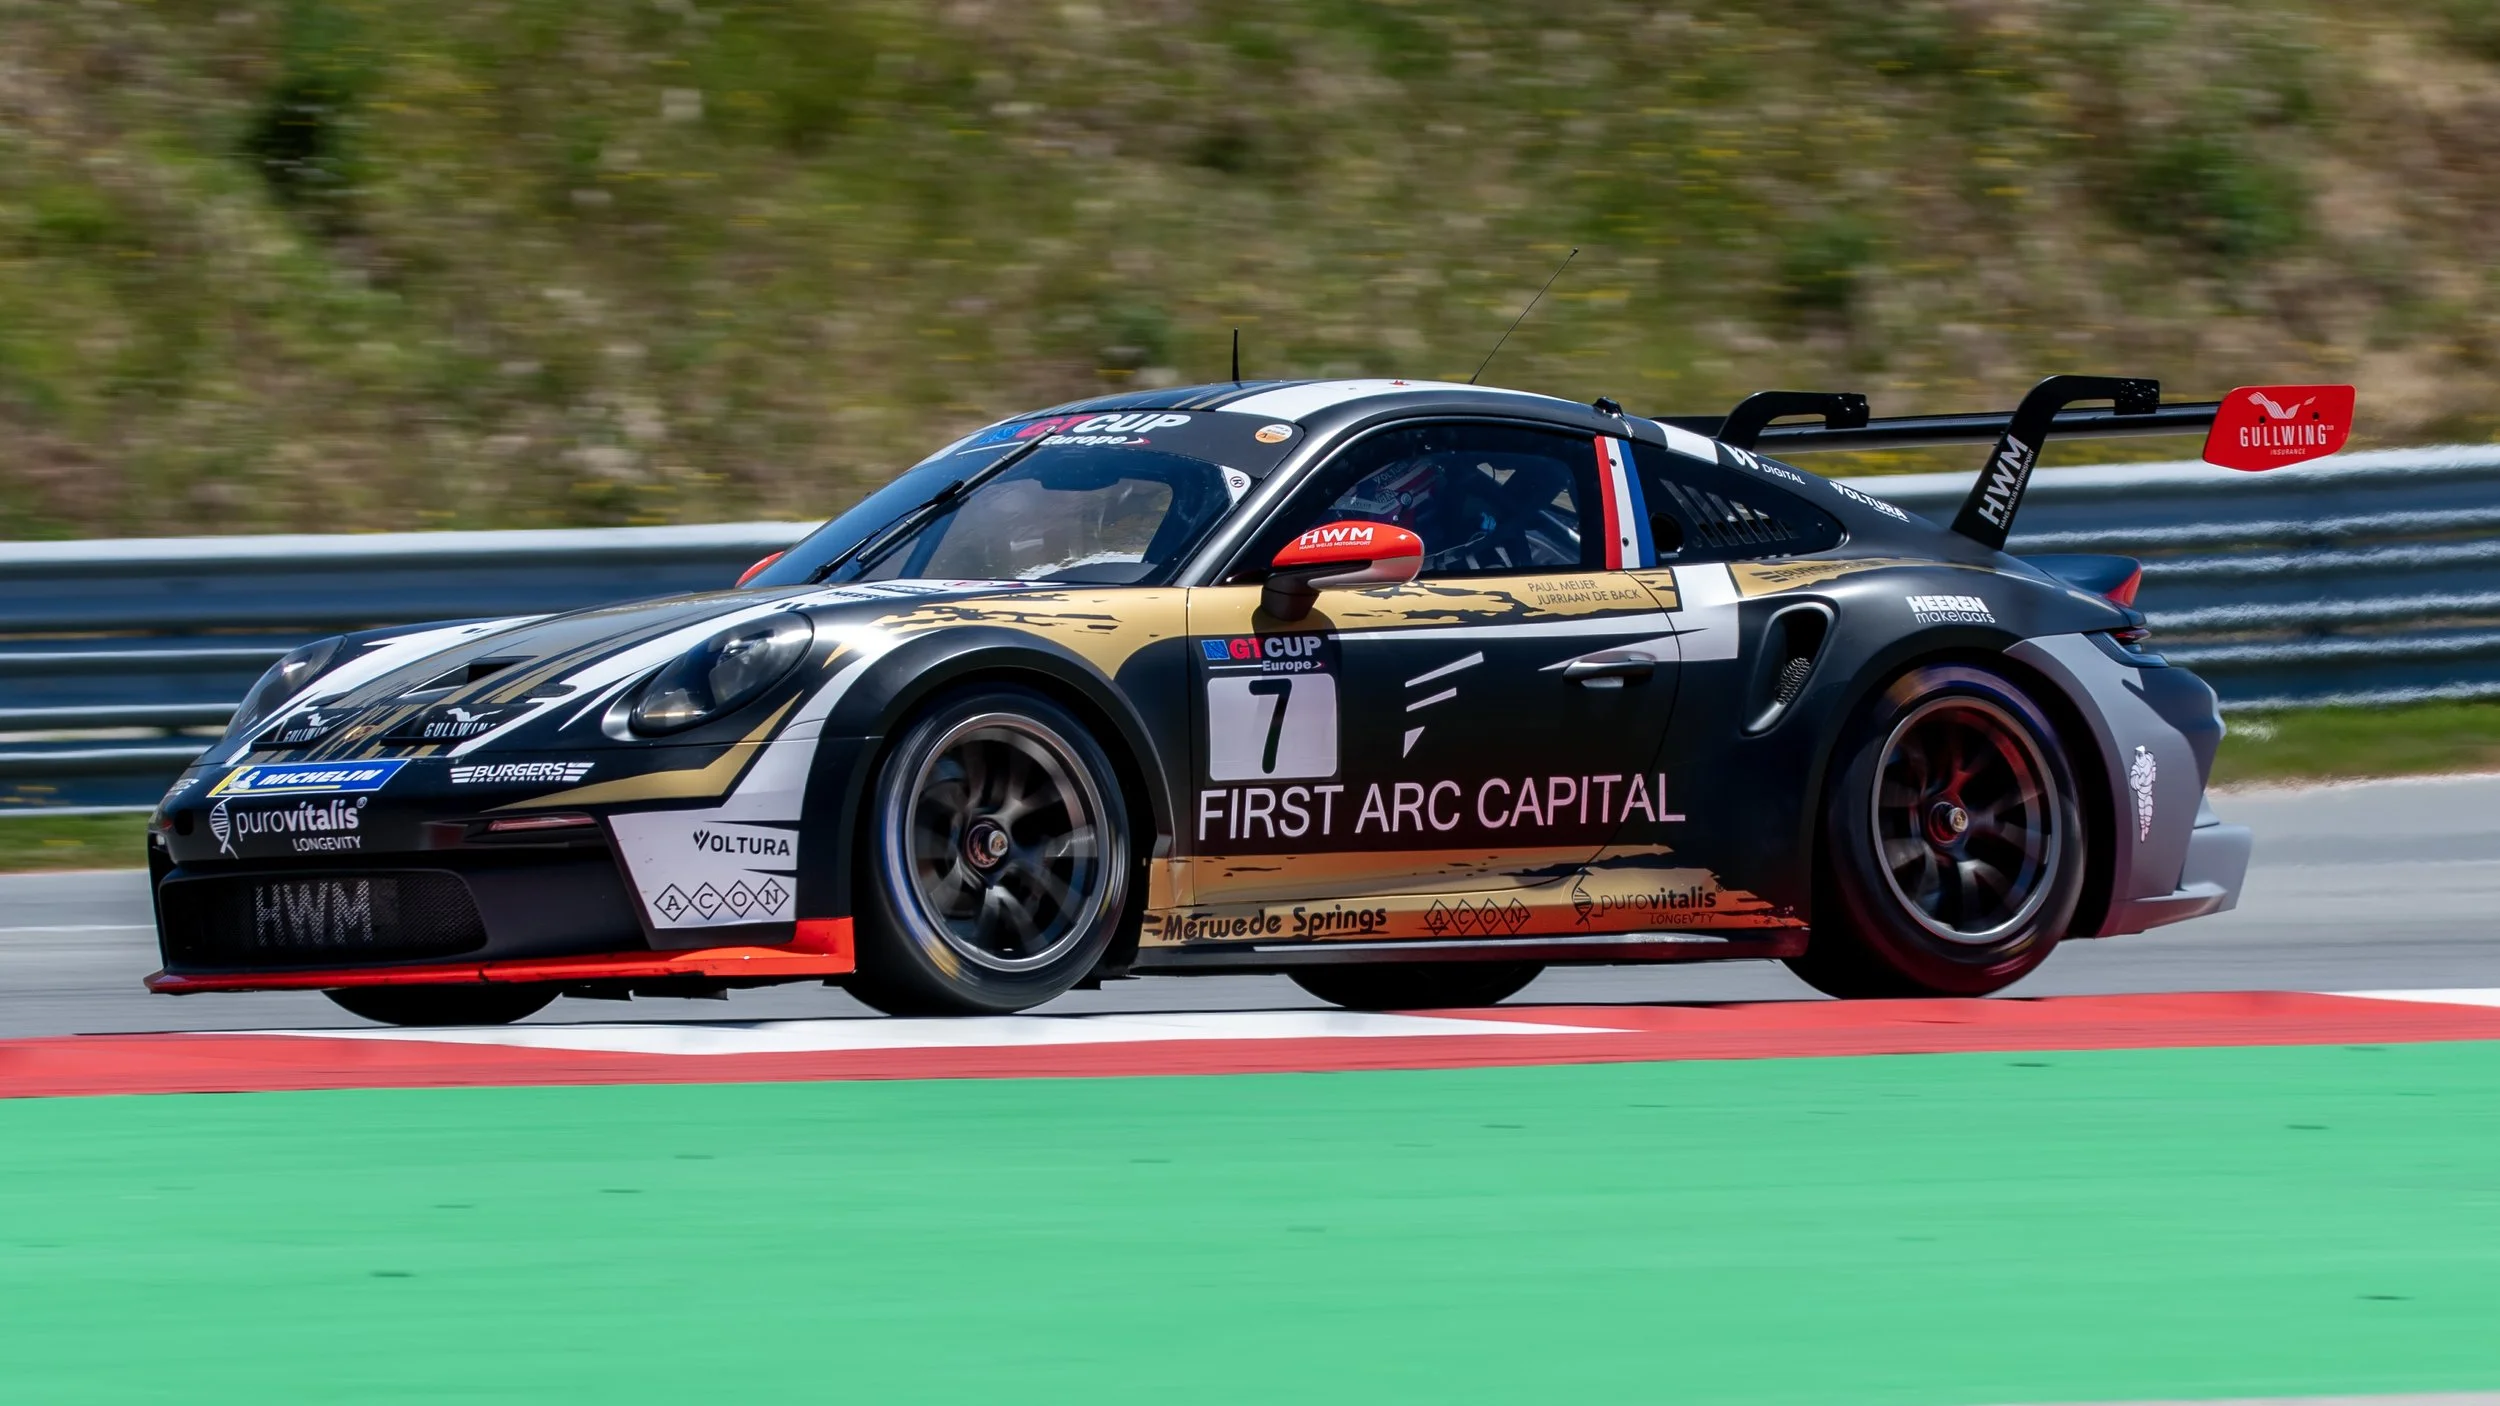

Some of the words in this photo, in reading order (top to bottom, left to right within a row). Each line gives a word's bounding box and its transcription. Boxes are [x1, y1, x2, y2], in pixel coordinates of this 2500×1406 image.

[1073, 413, 1191, 433] CUP
[1040, 434, 1128, 446] Europe
[2240, 424, 2327, 447] GULLWING
[2270, 448, 2306, 456] INSURANCE
[1762, 463, 1806, 485] DIGITAL
[1978, 433, 2029, 525] HWM
[2016, 448, 2034, 492] MOTORSPORT
[1829, 480, 1908, 520] VOLTURA
[1300, 527, 1374, 545] HWM
[1528, 582, 1558, 592] PAUL
[1560, 580, 1598, 590] MEIJER
[1537, 592, 1591, 606] JURRIAAN
[1593, 591, 1610, 602] DE
[1611, 589, 1642, 601] BACK
[1905, 595, 1989, 613] HEEREN
[1915, 611, 1996, 624] makelaars
[1264, 636, 1322, 658] CUP
[1262, 660, 1312, 672] Europe
[1248, 678, 1292, 774] 7
[257, 769, 384, 785] MICHELIN
[470, 775, 562, 783] RACETRAILERS
[473, 762, 566, 777] BURGERS
[1199, 784, 1344, 840] FIRST
[1354, 782, 1461, 834] ARC
[1477, 773, 1686, 828] CAPITAL
[293, 836, 361, 852] LONGEVITY
[693, 829, 790, 856] VOLTURA
[256, 880, 374, 946] HWM
[1162, 908, 1282, 941] Merwede
[1292, 903, 1387, 936] Springs
